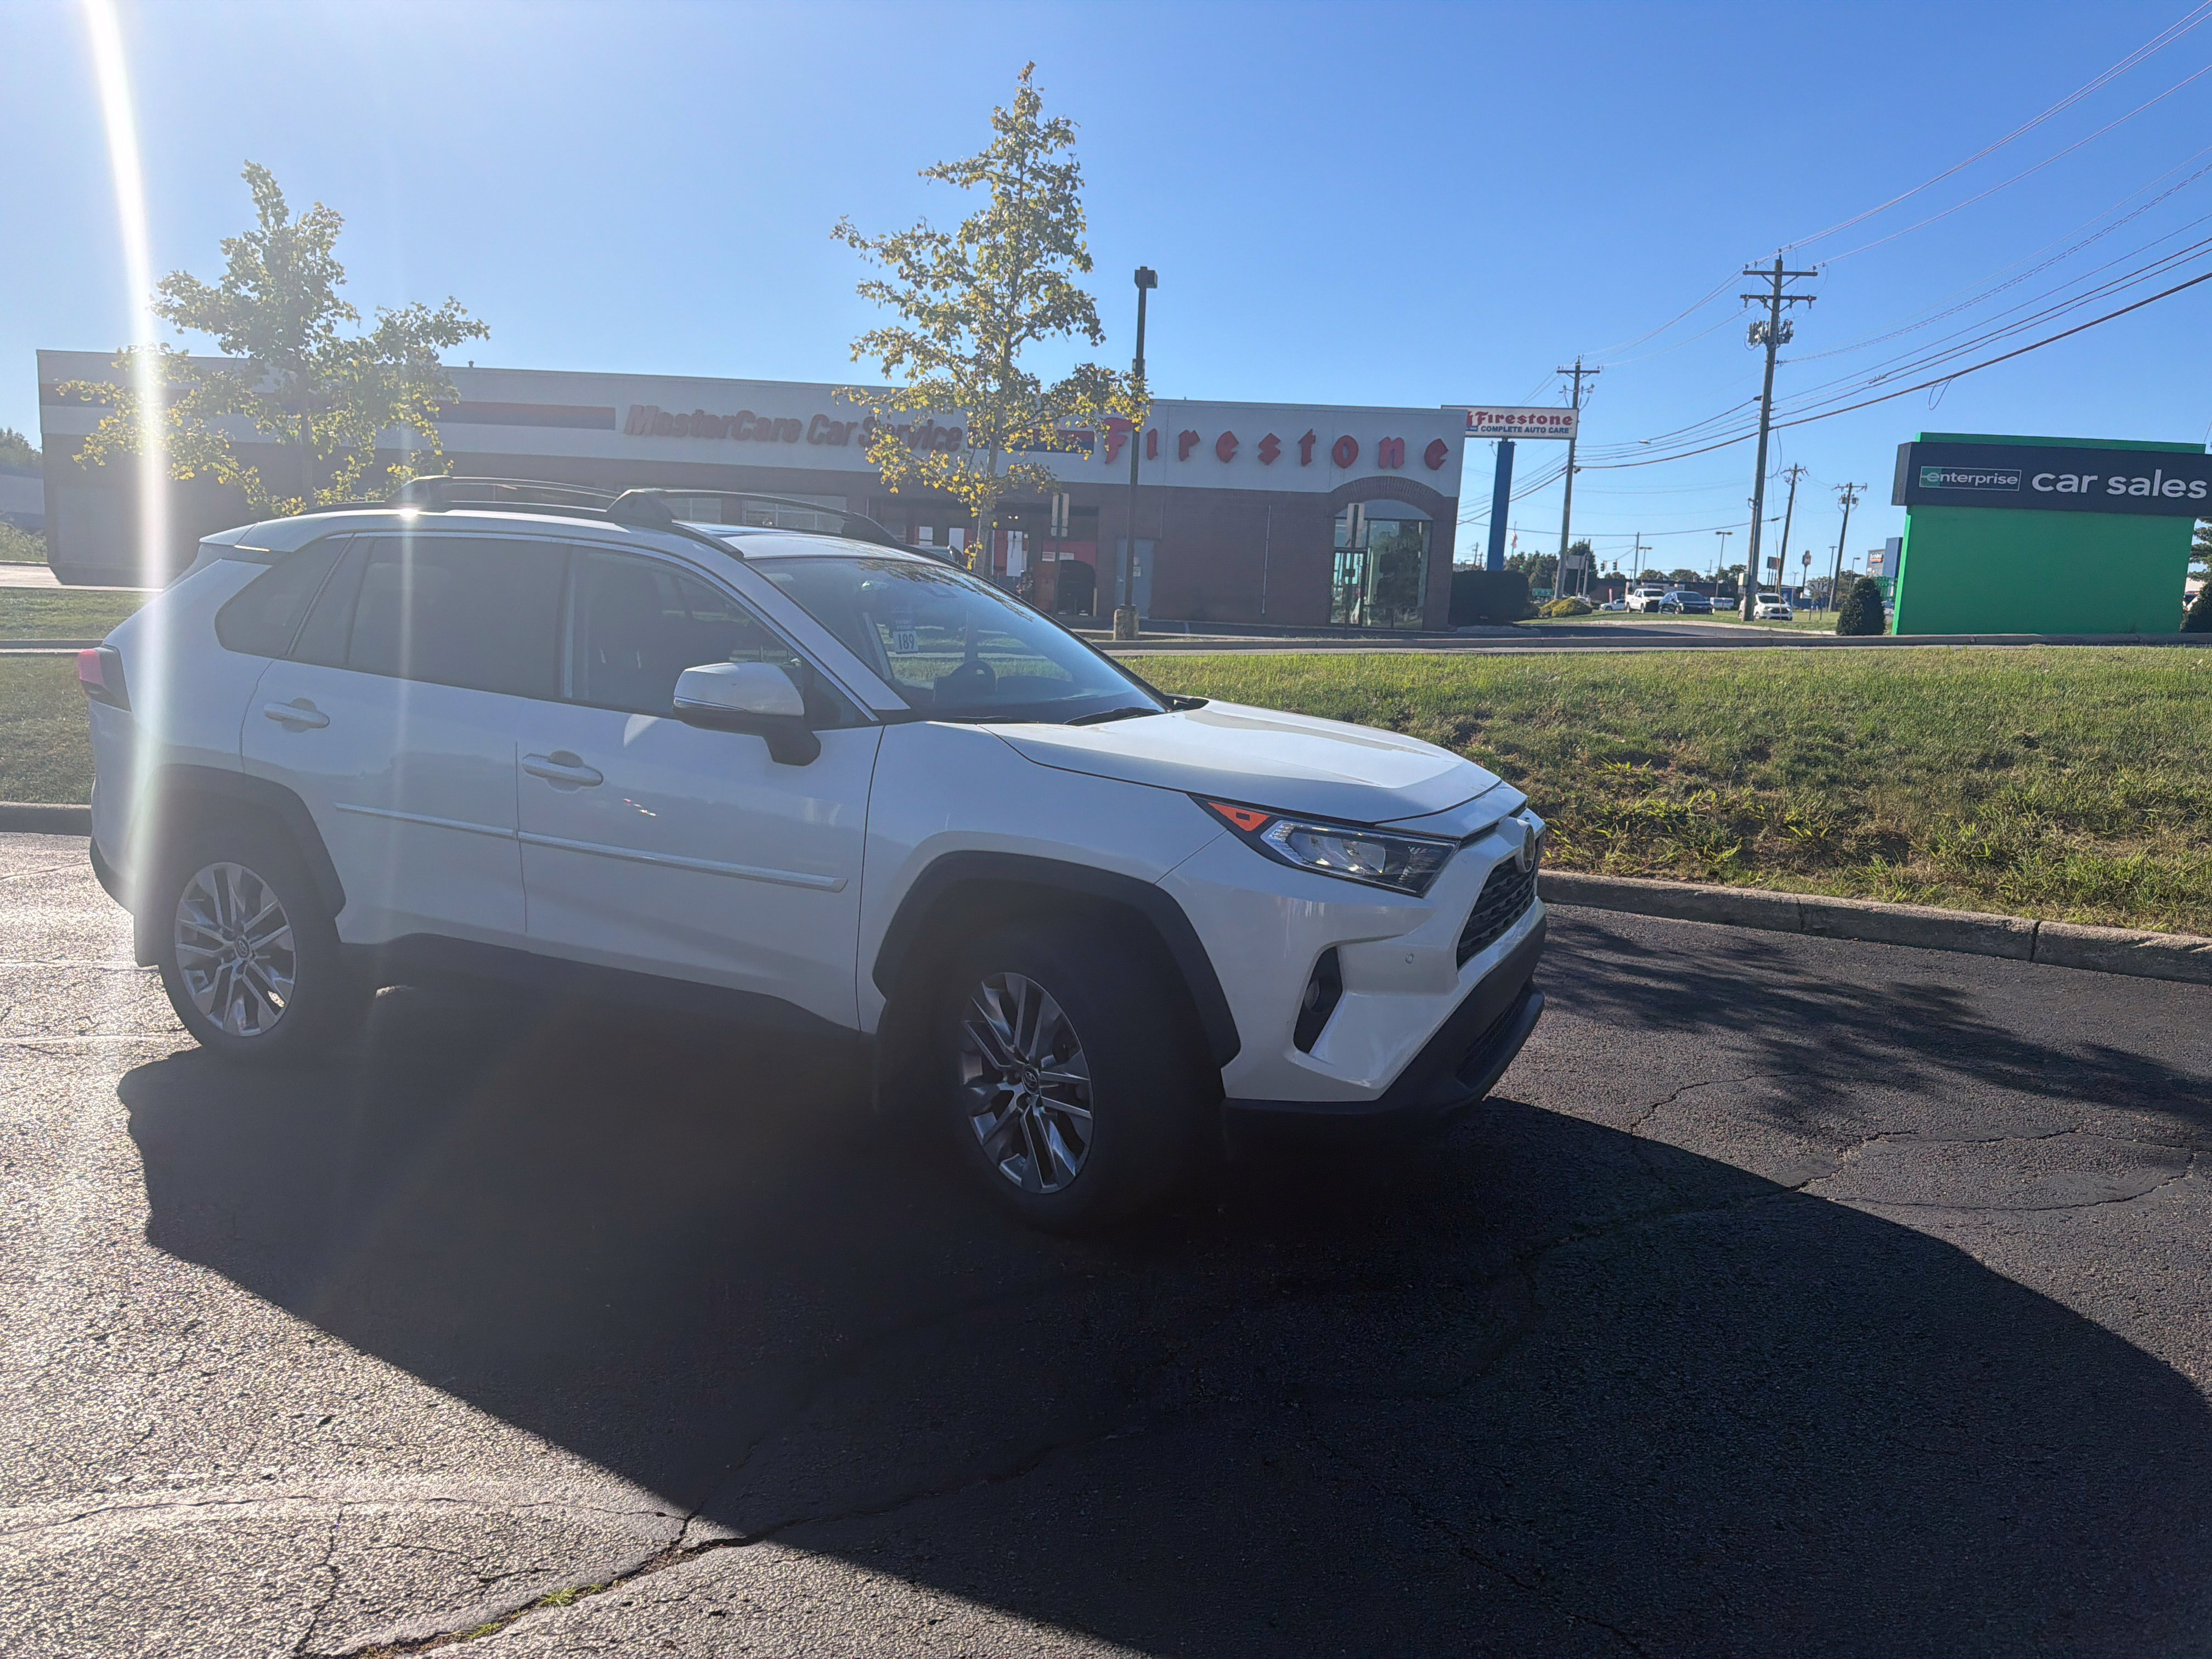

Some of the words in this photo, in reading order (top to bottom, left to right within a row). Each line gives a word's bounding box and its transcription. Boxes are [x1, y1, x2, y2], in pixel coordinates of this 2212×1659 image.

[624, 404, 803, 443] MasterCare
[808, 414, 858, 446] Car
[1475, 411, 1573, 426] Firestone
[1103, 417, 1449, 470] Firestone
[1927, 471, 2018, 486] enterprise
[2032, 472, 2098, 493] car
[2106, 469, 2208, 499] sales
[898, 633, 915, 650] 189
